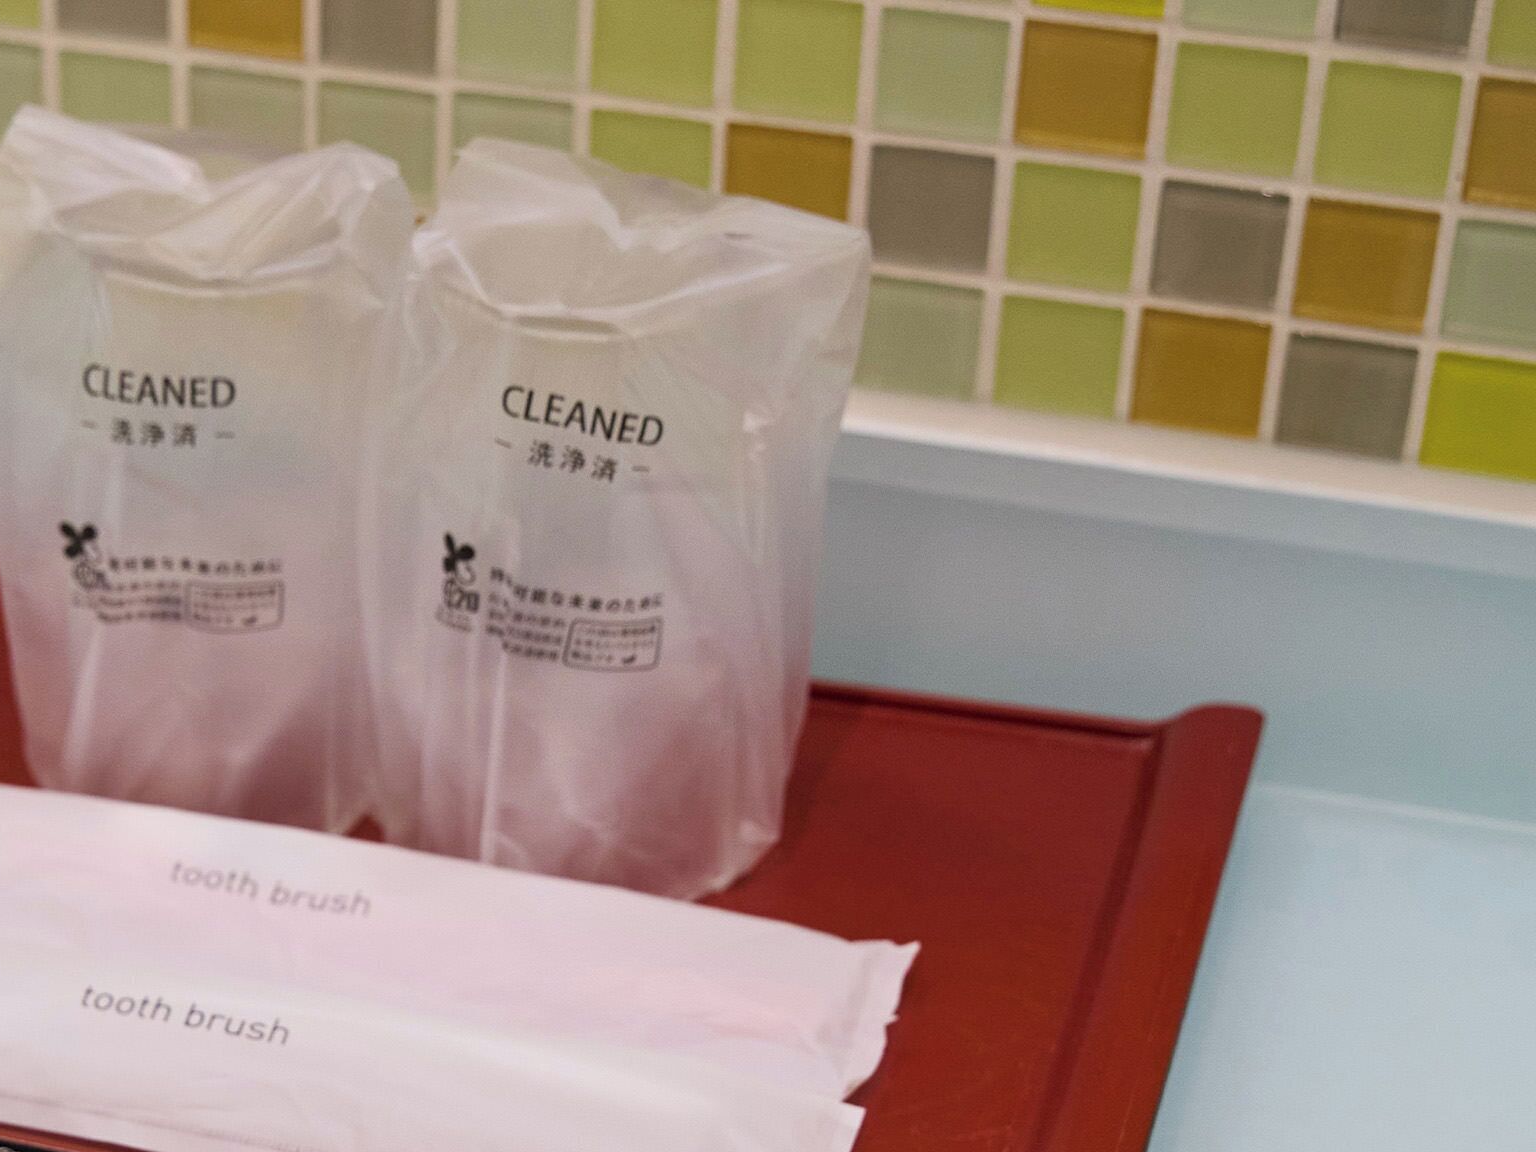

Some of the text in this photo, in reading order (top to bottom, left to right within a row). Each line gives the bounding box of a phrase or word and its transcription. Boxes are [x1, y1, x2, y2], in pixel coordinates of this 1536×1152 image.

[82, 362, 236, 408] CLEANED
[501, 384, 664, 446] CLEANED
[169, 861, 371, 916] tooth brush
[81, 986, 290, 1045] tooth brush
